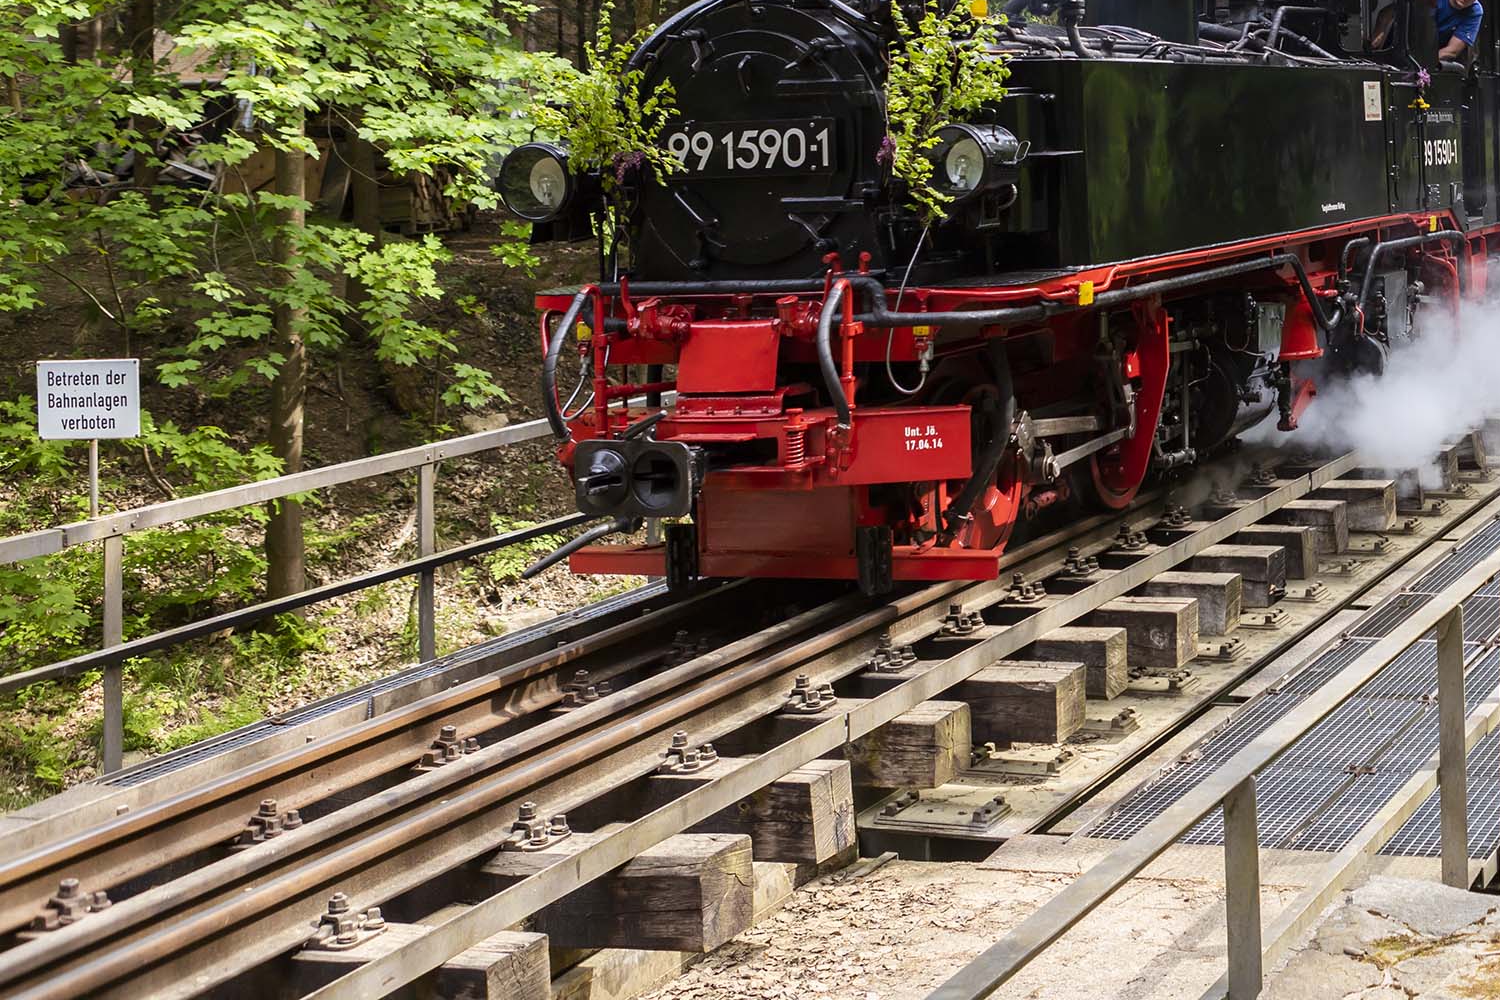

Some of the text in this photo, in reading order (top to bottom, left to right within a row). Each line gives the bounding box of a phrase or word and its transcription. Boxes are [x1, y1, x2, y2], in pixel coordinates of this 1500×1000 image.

[668, 131, 714, 172] 99
[1433, 138, 1458, 166] 1590-1
[47, 369, 127, 387] Betreten der
[48, 392, 128, 411] Bahnanlagen
[61, 414, 116, 430] verboten
[904, 426, 922, 437] Unt.
